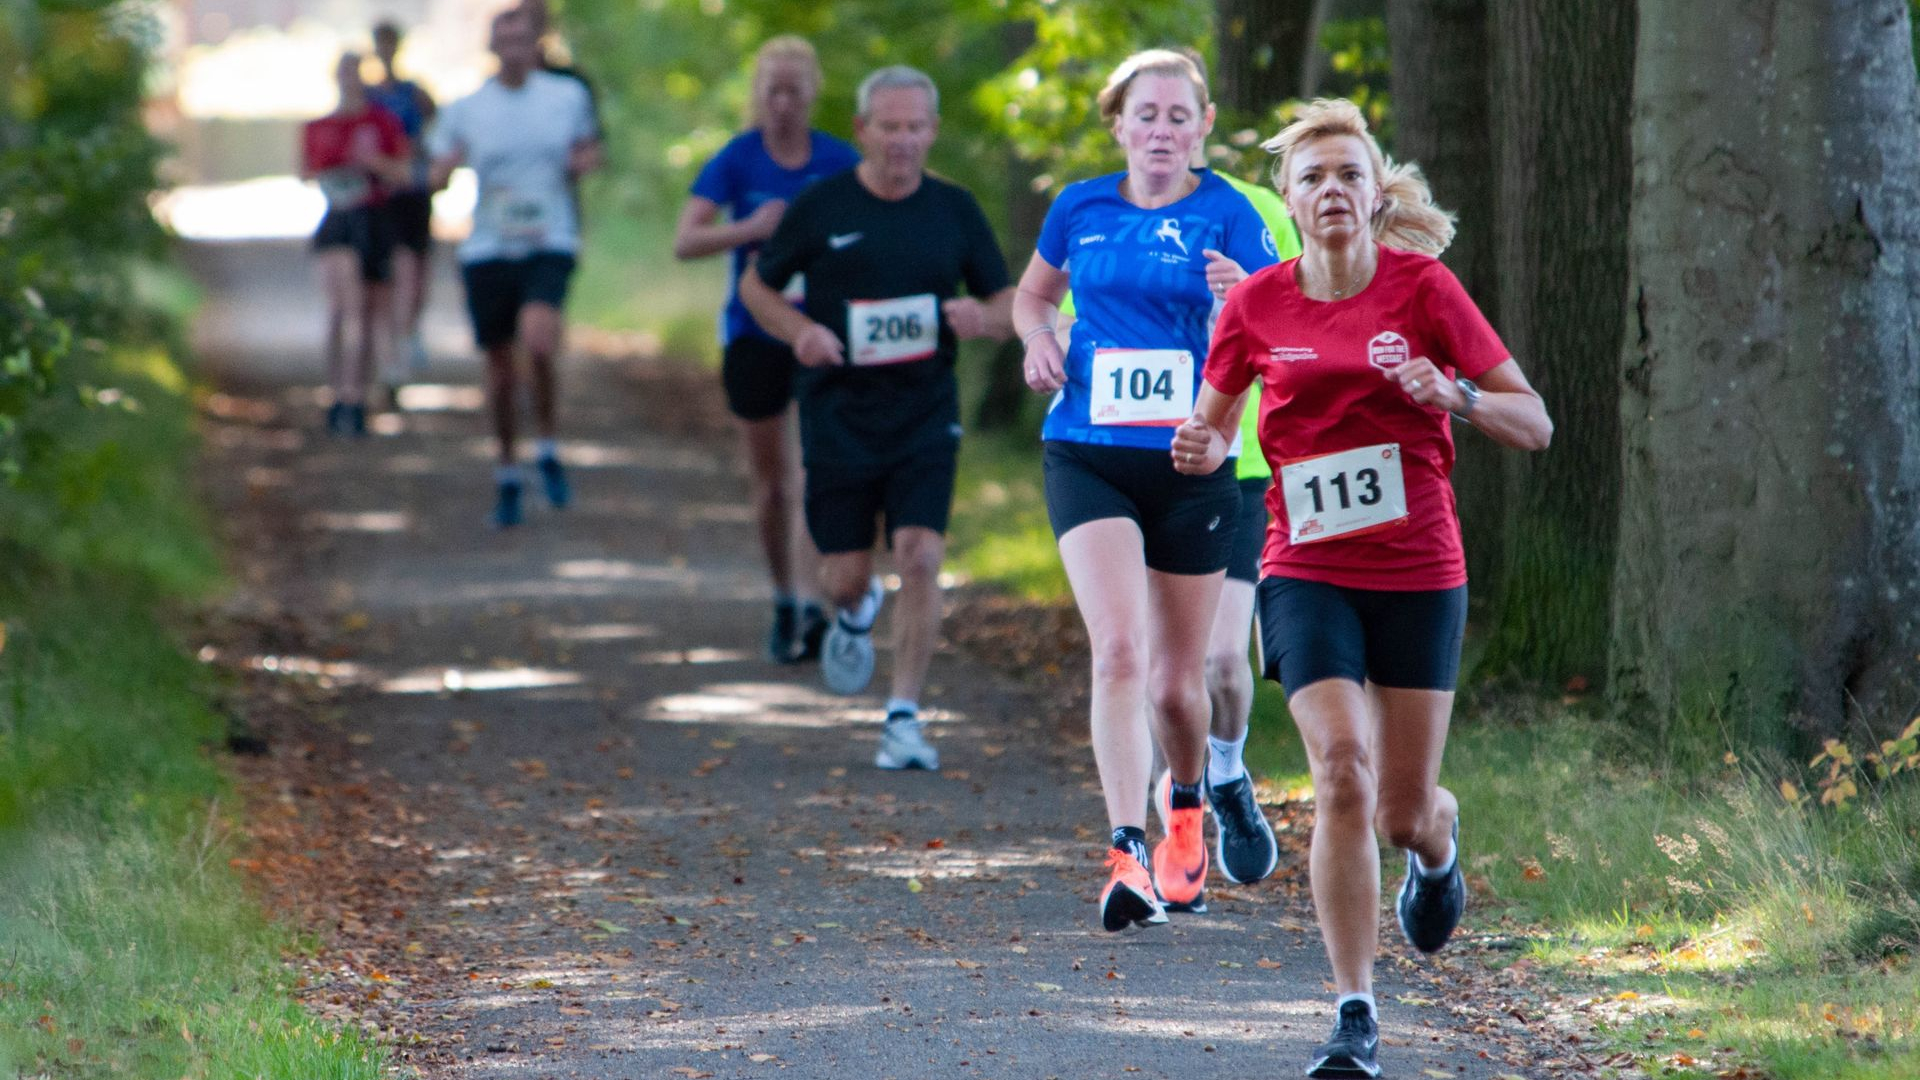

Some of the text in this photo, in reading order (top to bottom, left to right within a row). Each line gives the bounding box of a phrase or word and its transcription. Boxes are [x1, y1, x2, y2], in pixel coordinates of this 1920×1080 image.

[866, 312, 922, 343] 206
[1110, 367, 1175, 401] 104
[1304, 468, 1383, 513] 113
